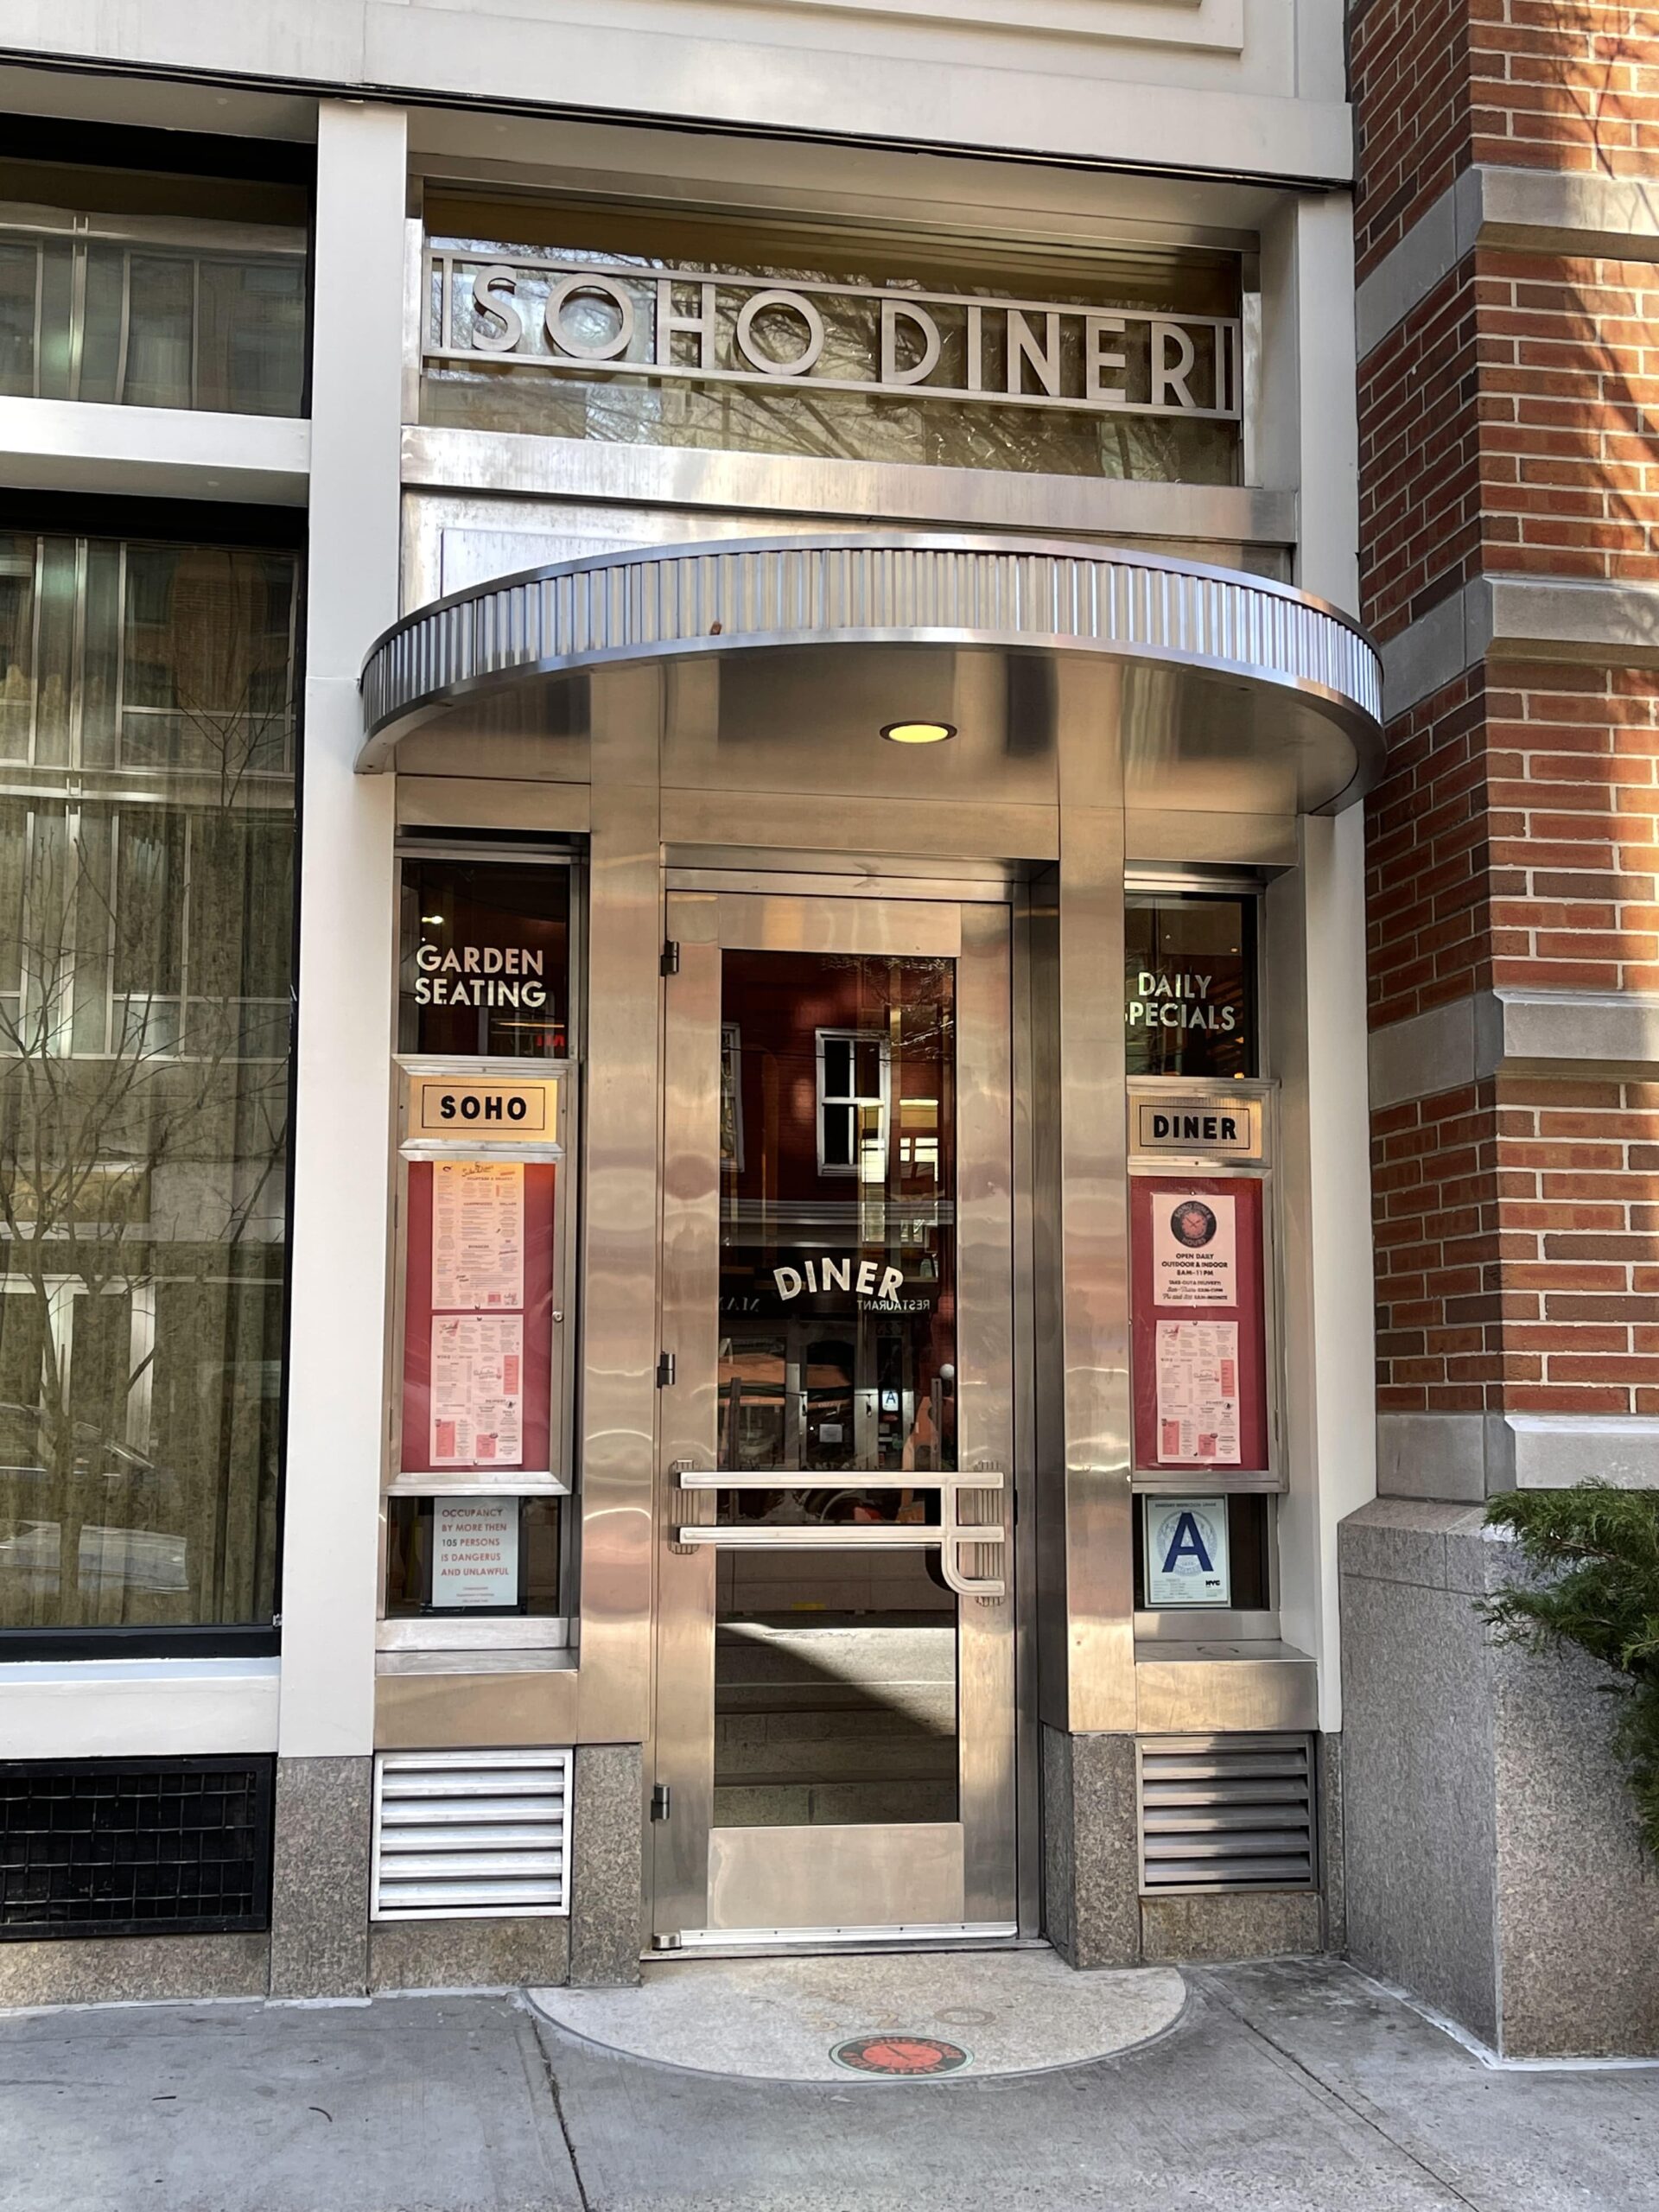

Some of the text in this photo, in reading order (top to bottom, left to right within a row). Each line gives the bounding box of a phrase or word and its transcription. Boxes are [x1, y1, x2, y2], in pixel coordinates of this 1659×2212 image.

[473, 264, 1196, 409] SOHO DINER
[416, 944, 543, 976] GARDEN
[415, 977, 546, 1007] SEATING
[1138, 972, 1212, 999] DAILY
[1125, 1001, 1236, 1031] PECIALS
[440, 1096, 527, 1121] SOHO
[1153, 1115, 1237, 1141] DINER
[773, 1257, 904, 1302] DINER
[442, 1509, 503, 1518] OCCUPANCY
[455, 1523, 483, 1532] MORE
[460, 1538, 500, 1547] PERSONS
[1161, 1512, 1214, 1573] A
[451, 1553, 501, 1561] DANGERUS
[463, 1567, 509, 1576] UNLAWFUL
[857, 2037, 918, 2047] SOHO
[882, 2064, 946, 2075] APART
